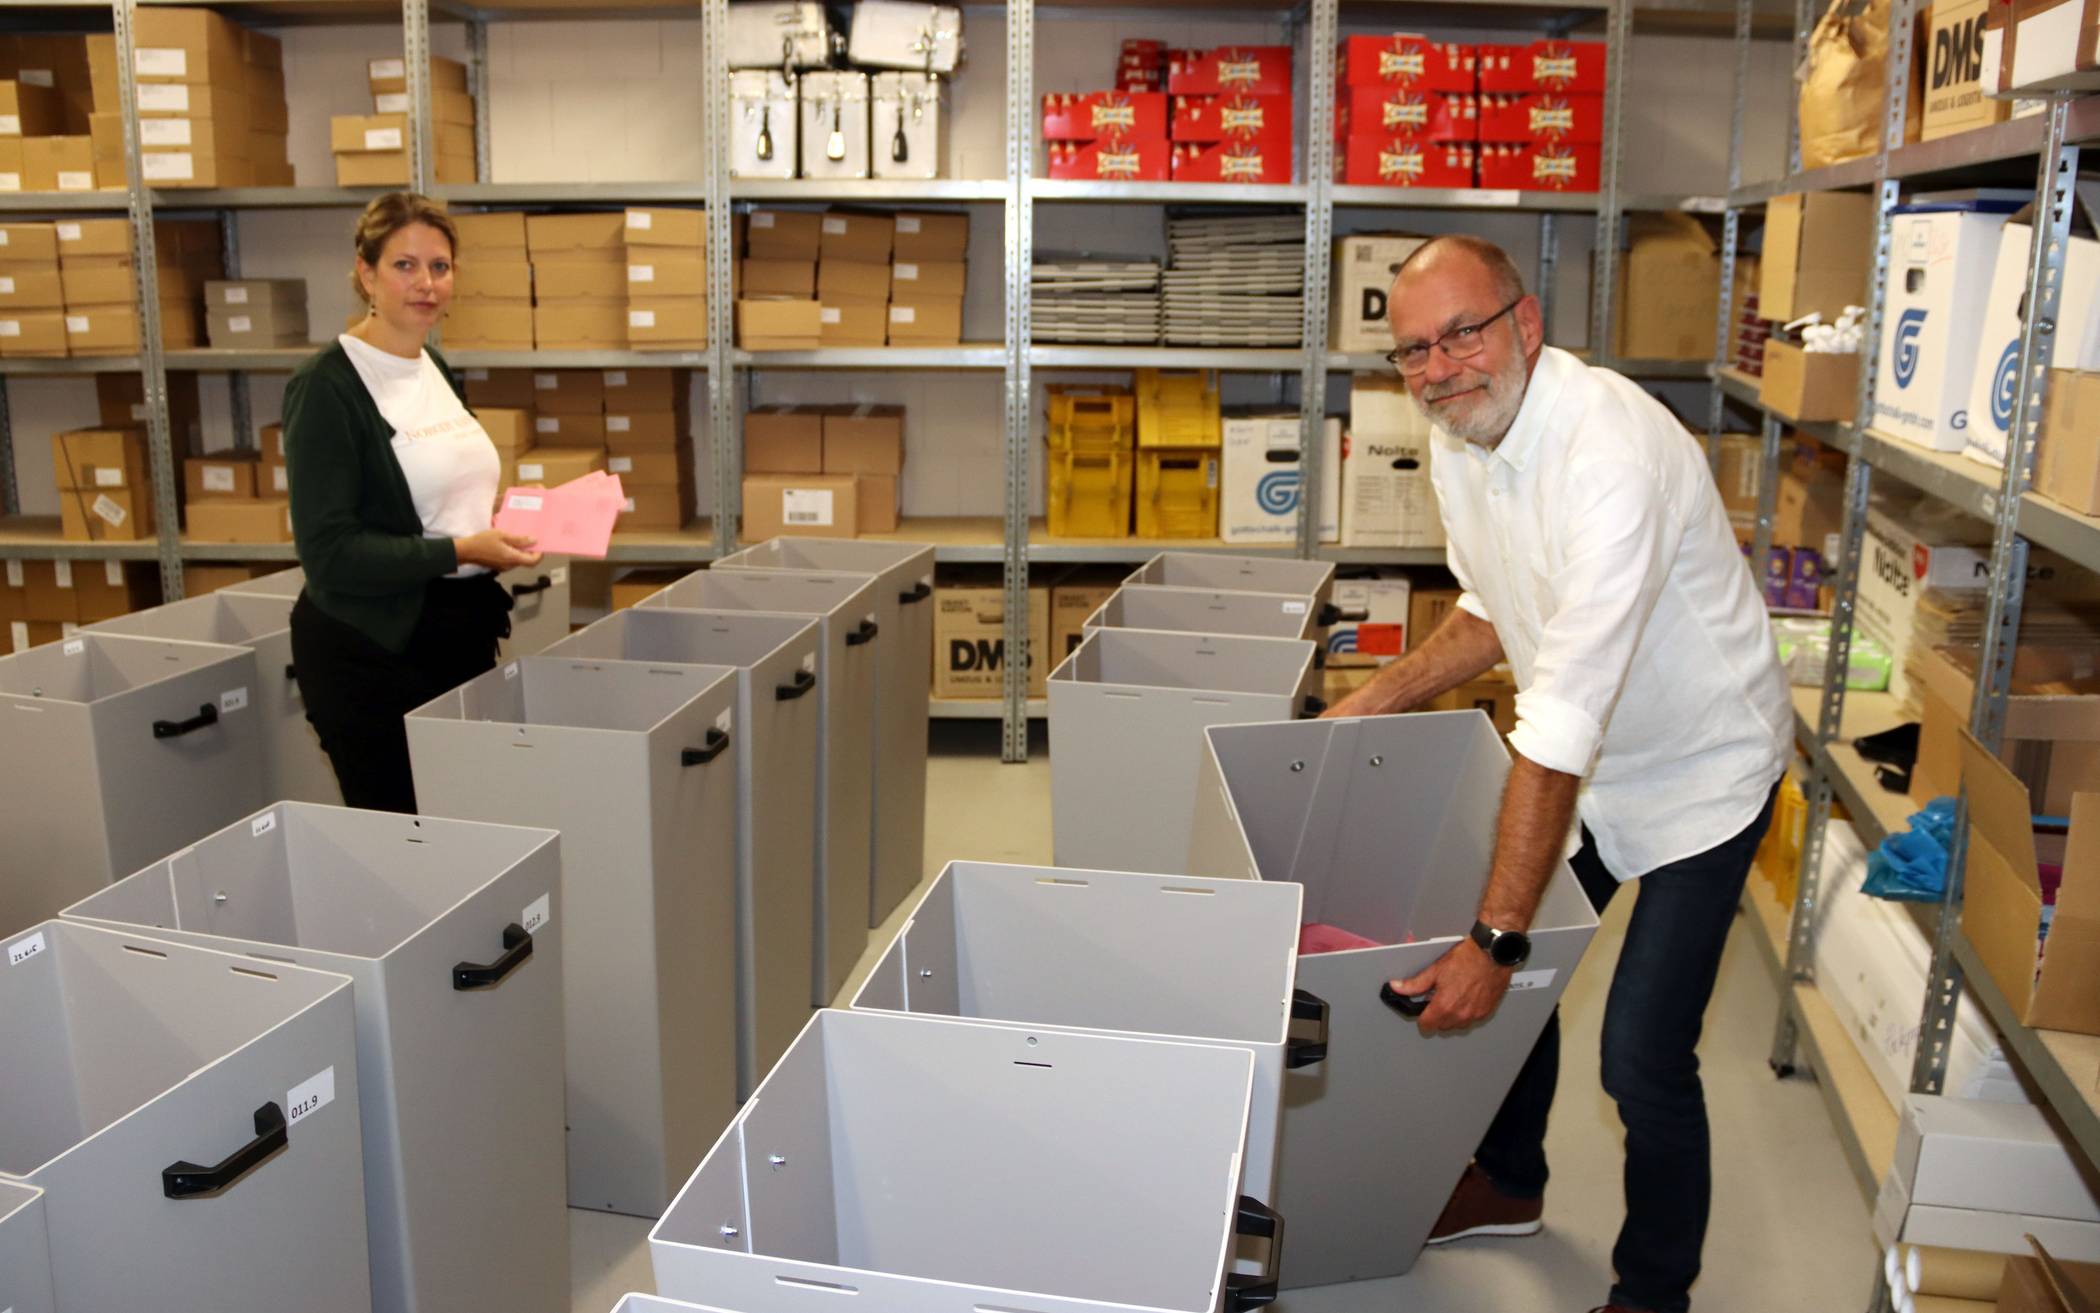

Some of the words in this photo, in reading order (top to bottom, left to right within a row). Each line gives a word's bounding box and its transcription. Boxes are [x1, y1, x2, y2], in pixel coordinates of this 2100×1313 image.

[1933, 12, 1989, 90] DMS
[1951, 410, 1968, 430] G
[291, 1094, 318, 1119] 011.9
